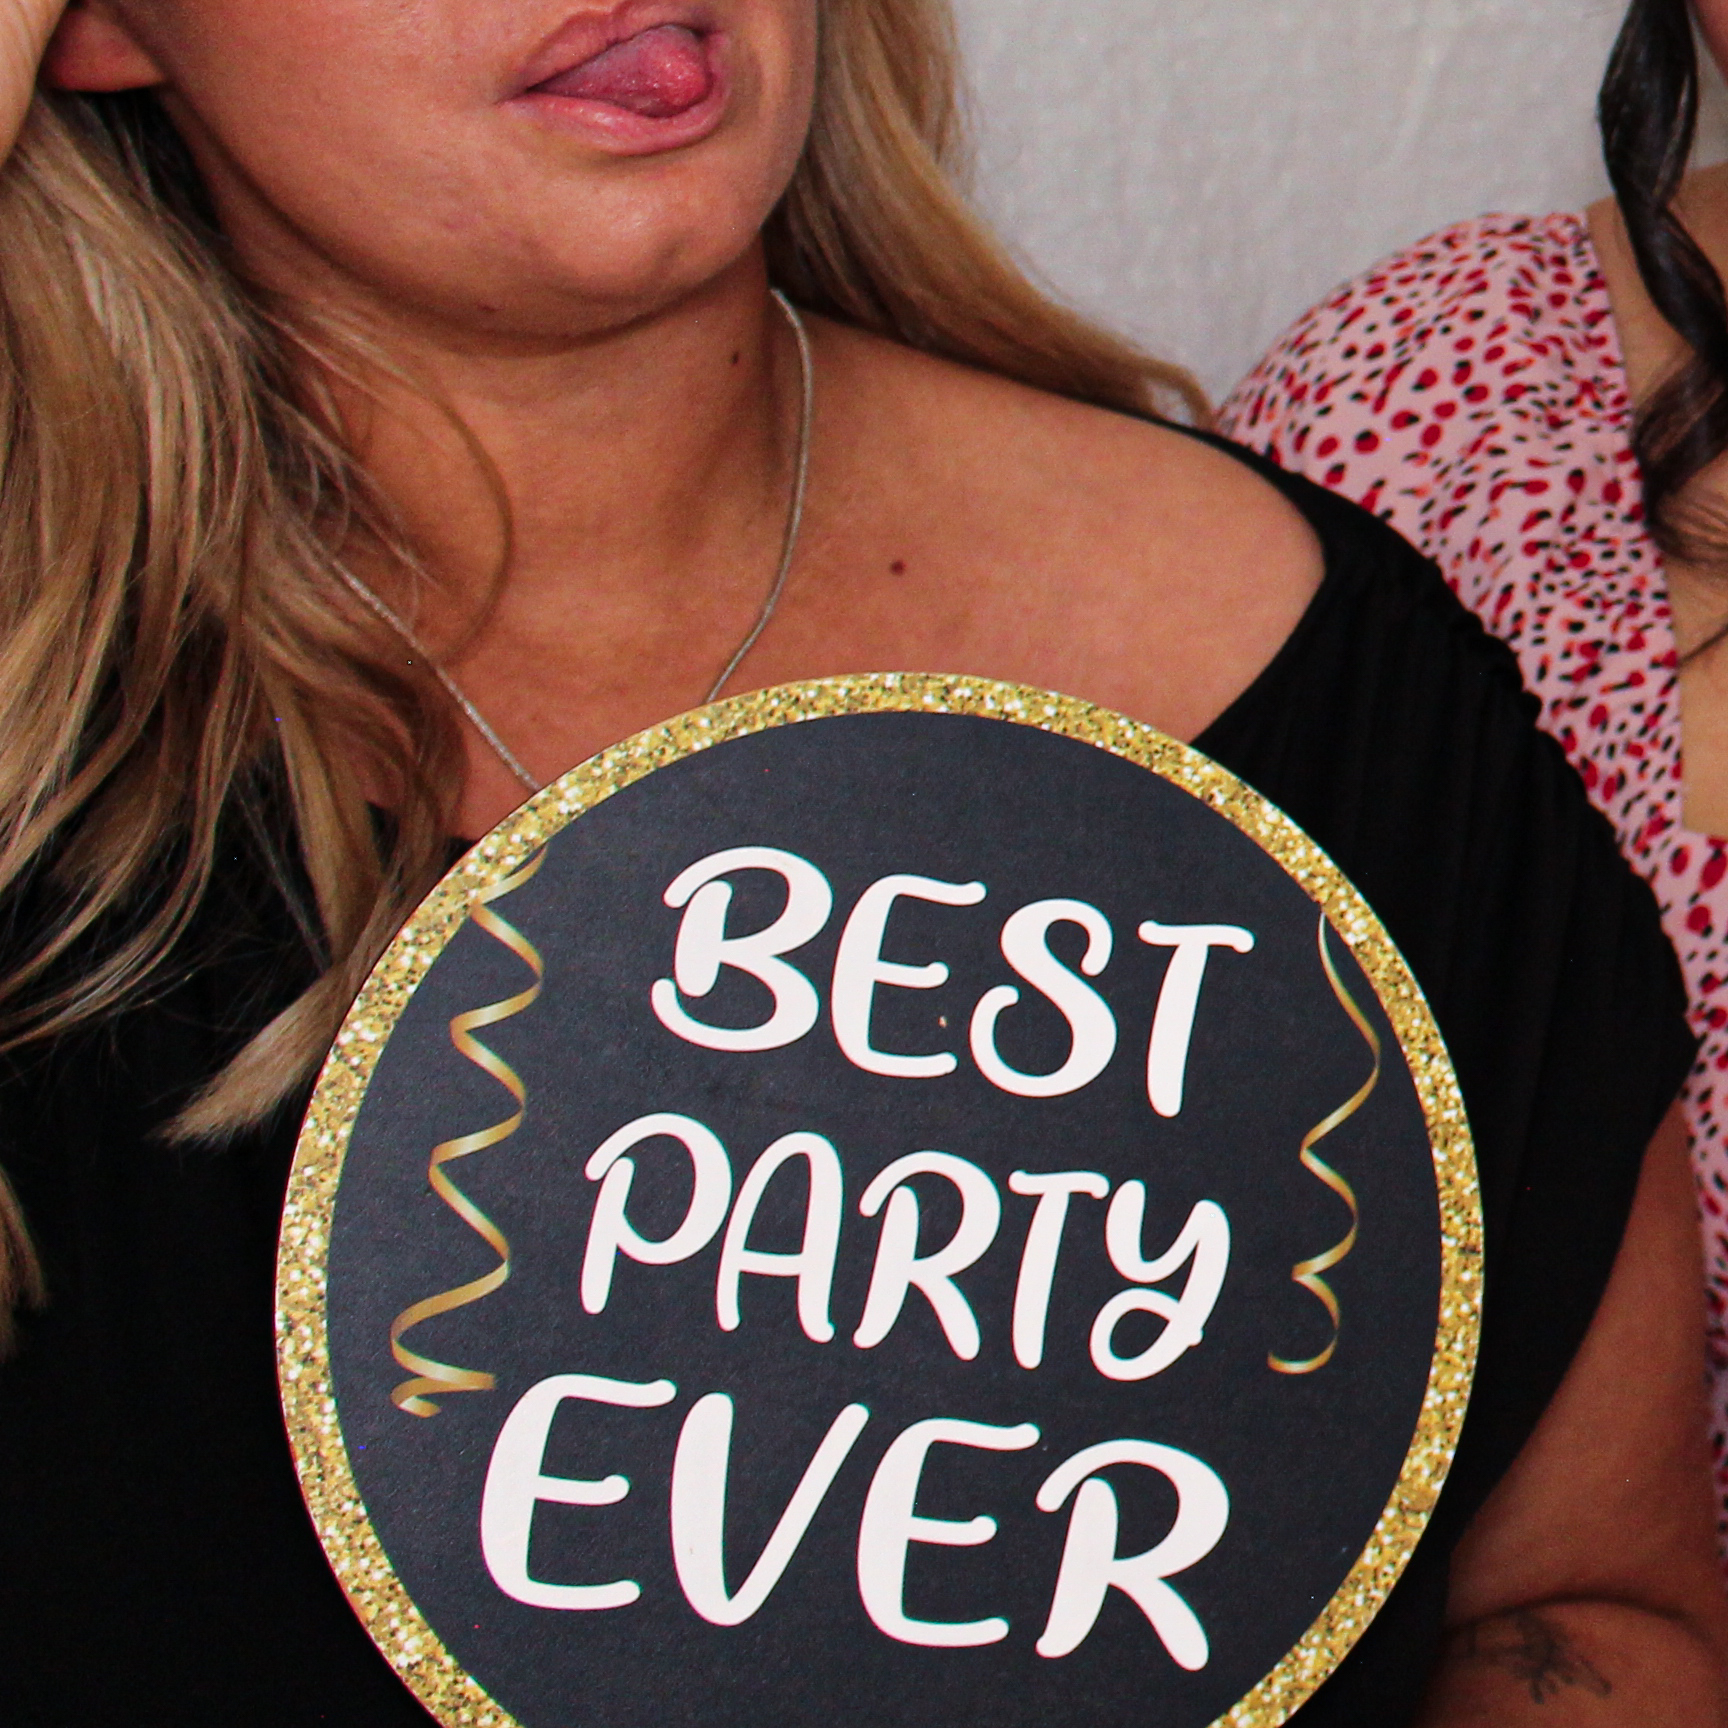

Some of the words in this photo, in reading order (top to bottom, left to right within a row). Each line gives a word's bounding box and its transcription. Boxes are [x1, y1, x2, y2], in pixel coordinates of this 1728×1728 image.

[650, 845, 1255, 1118] BEST
[580, 1112, 1231, 1382] PARTY
[479, 1373, 1230, 1672] EVER
